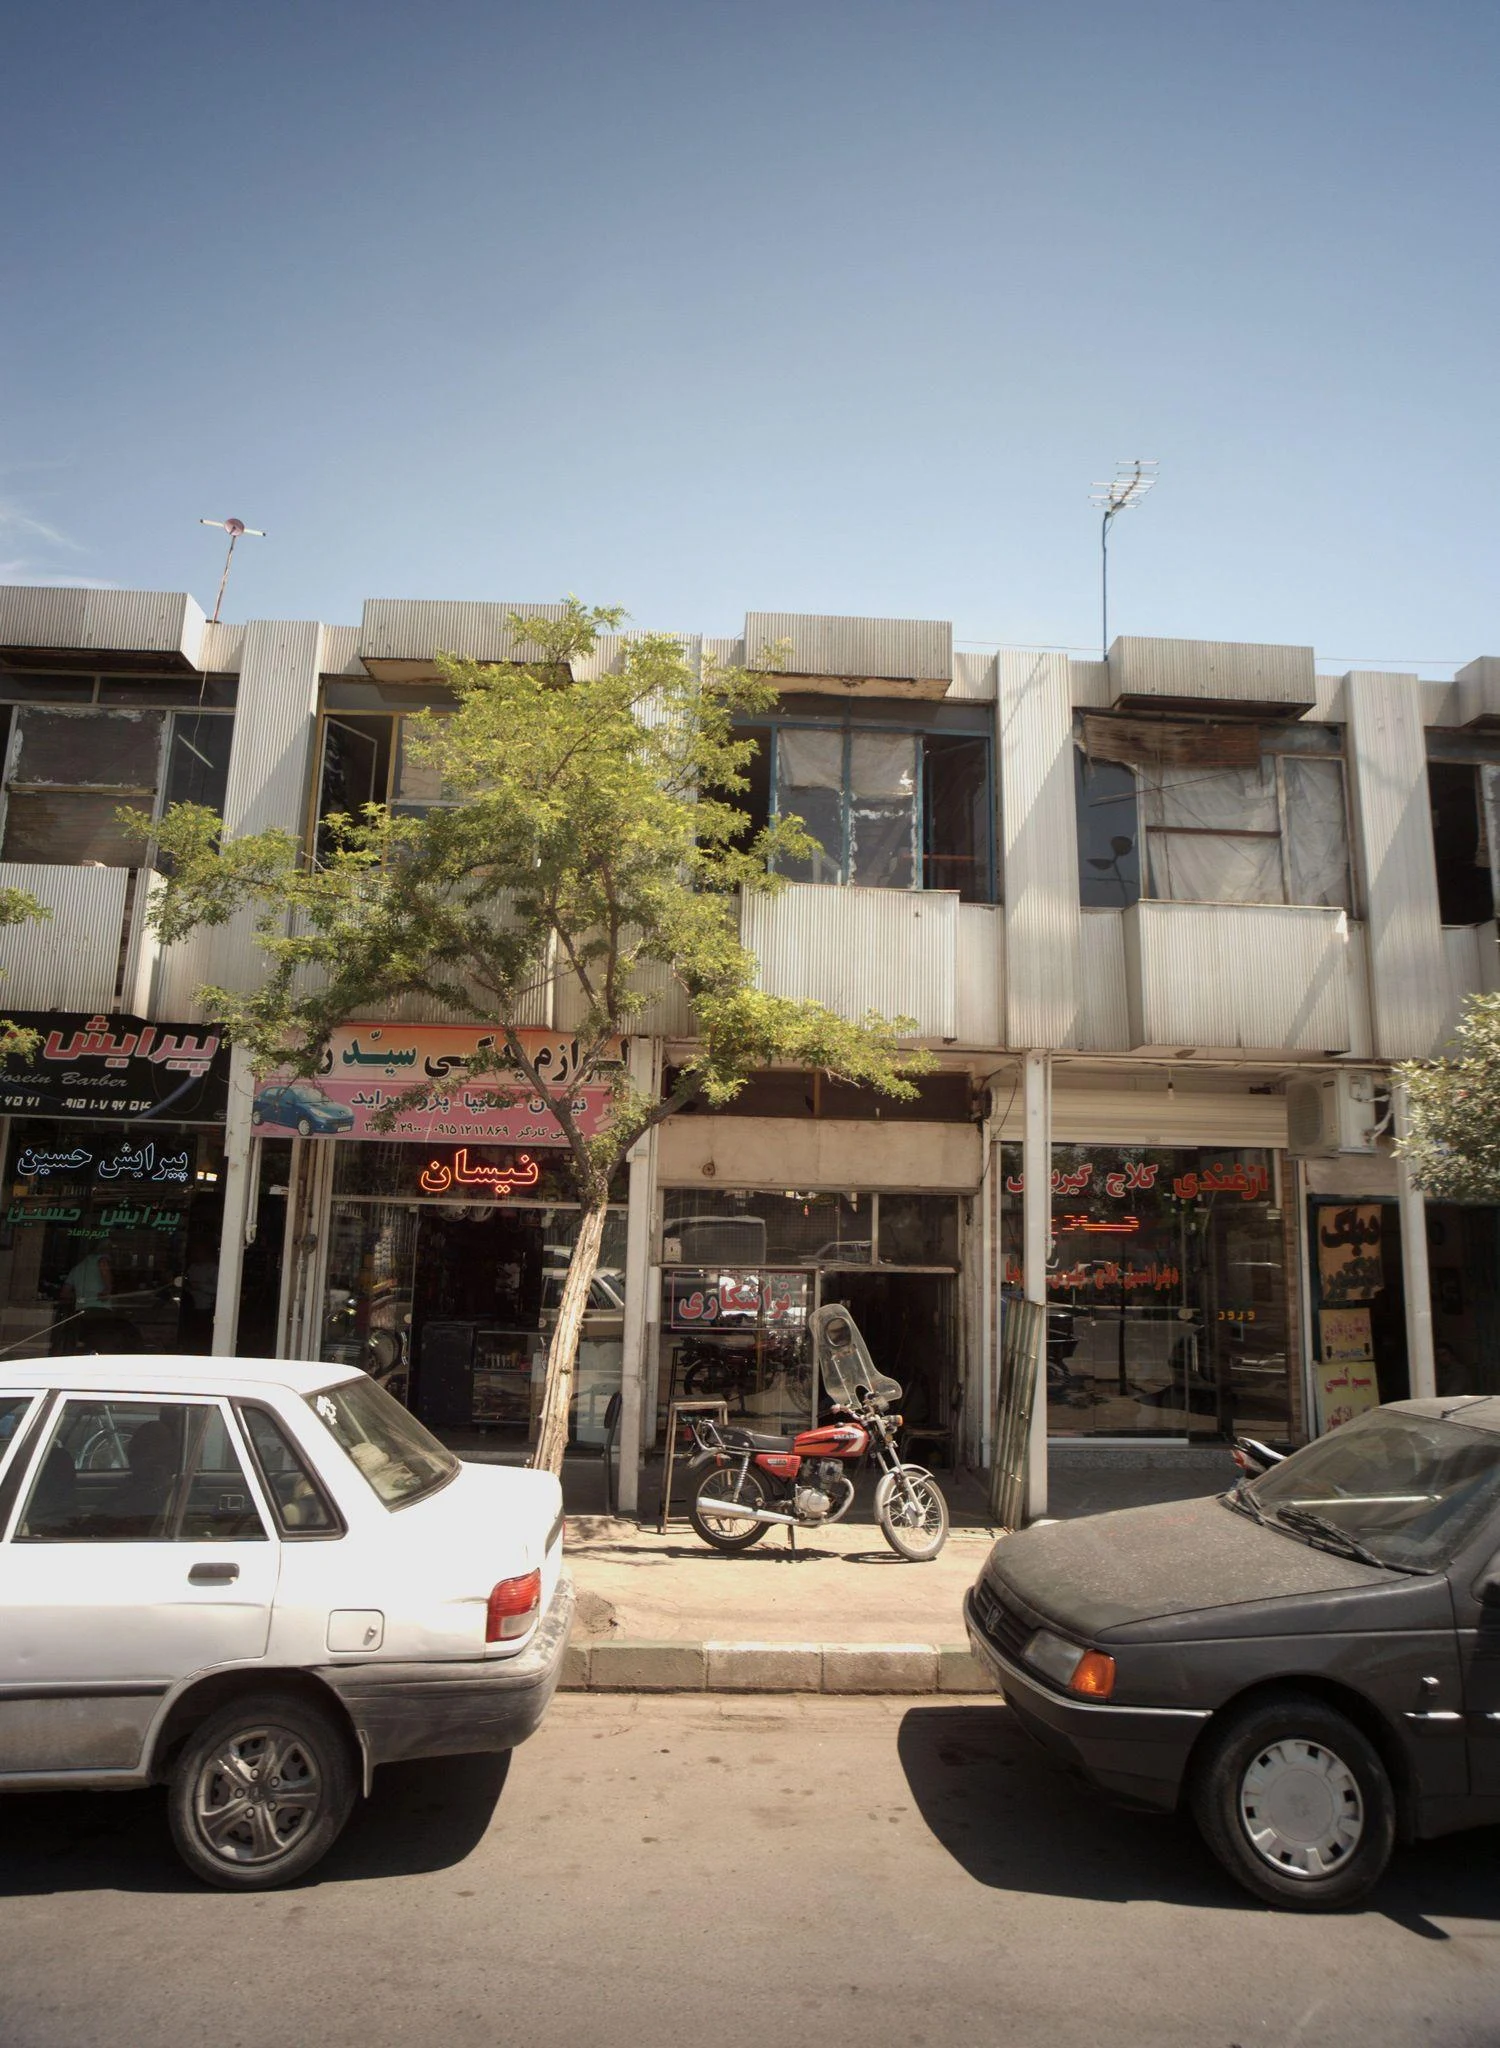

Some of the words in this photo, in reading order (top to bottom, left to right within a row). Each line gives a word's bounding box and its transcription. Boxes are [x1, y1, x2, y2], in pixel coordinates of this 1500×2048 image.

[45, 1015, 220, 1077] پیرایش
[0, 1070, 53, 1085] osein
[61, 1071, 129, 1087] Barber
[17, 1148, 93, 1176] حسین
[99, 1142, 189, 1182] پیرایش
[420, 1148, 539, 1194] نیسان
[1105, 1162, 1159, 1197] کلاچ
[1172, 1162, 1269, 1200] ازغندی
[6, 1198, 82, 1226] حسین
[99, 1196, 182, 1235] پیرایش
[678, 1281, 791, 1319] تراشکاری
